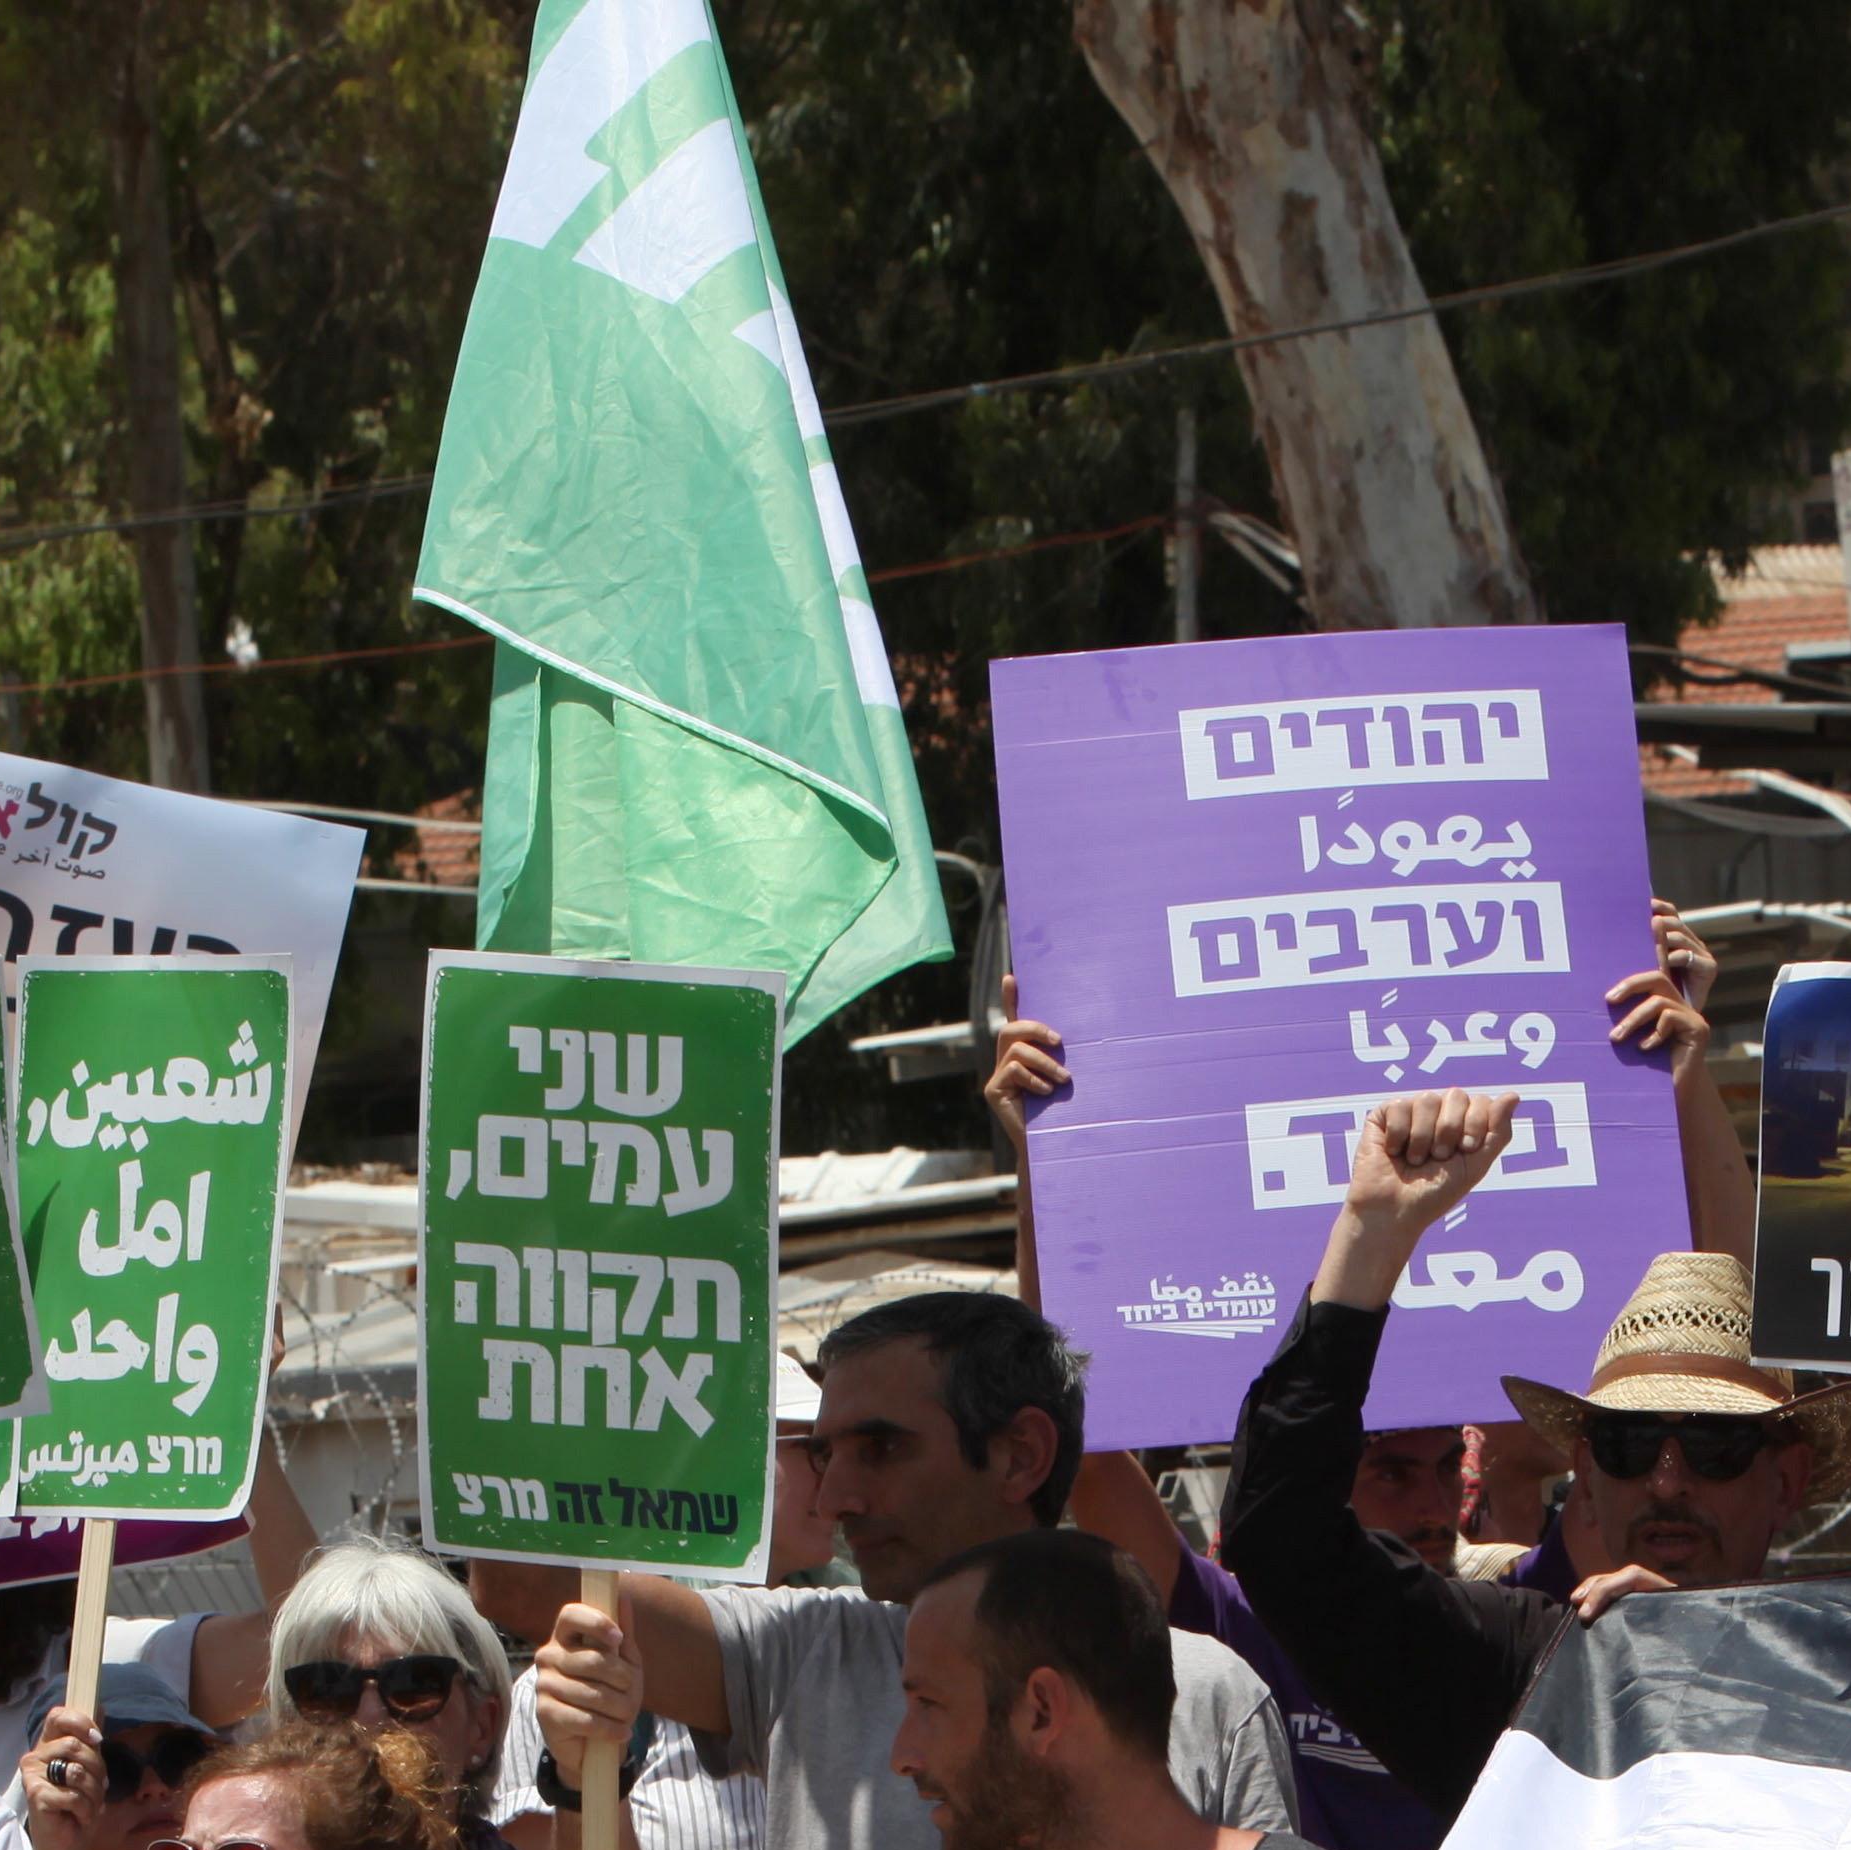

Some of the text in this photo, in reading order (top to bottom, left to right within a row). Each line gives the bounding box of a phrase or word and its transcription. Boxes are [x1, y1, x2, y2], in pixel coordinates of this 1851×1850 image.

[1204, 701, 1520, 780] יהודים
[24, 782, 118, 860] קול
[55, 858, 106, 880] صوت
[1190, 899, 1544, 985] וערבים
[508, 1025, 683, 1117] שני
[445, 1114, 734, 1217] עמים,
[78, 1159, 211, 1277] امل
[453, 1241, 741, 1346] תקווה
[1117, 1299, 1276, 1322] עומדים ביחד
[44, 1292, 219, 1416] واحد
[477, 1338, 715, 1438] אחת
[19, 1431, 139, 1488] ميرتس
[147, 1434, 222, 1475] מרצ
[452, 1472, 738, 1534] שמאל זה מרצ
